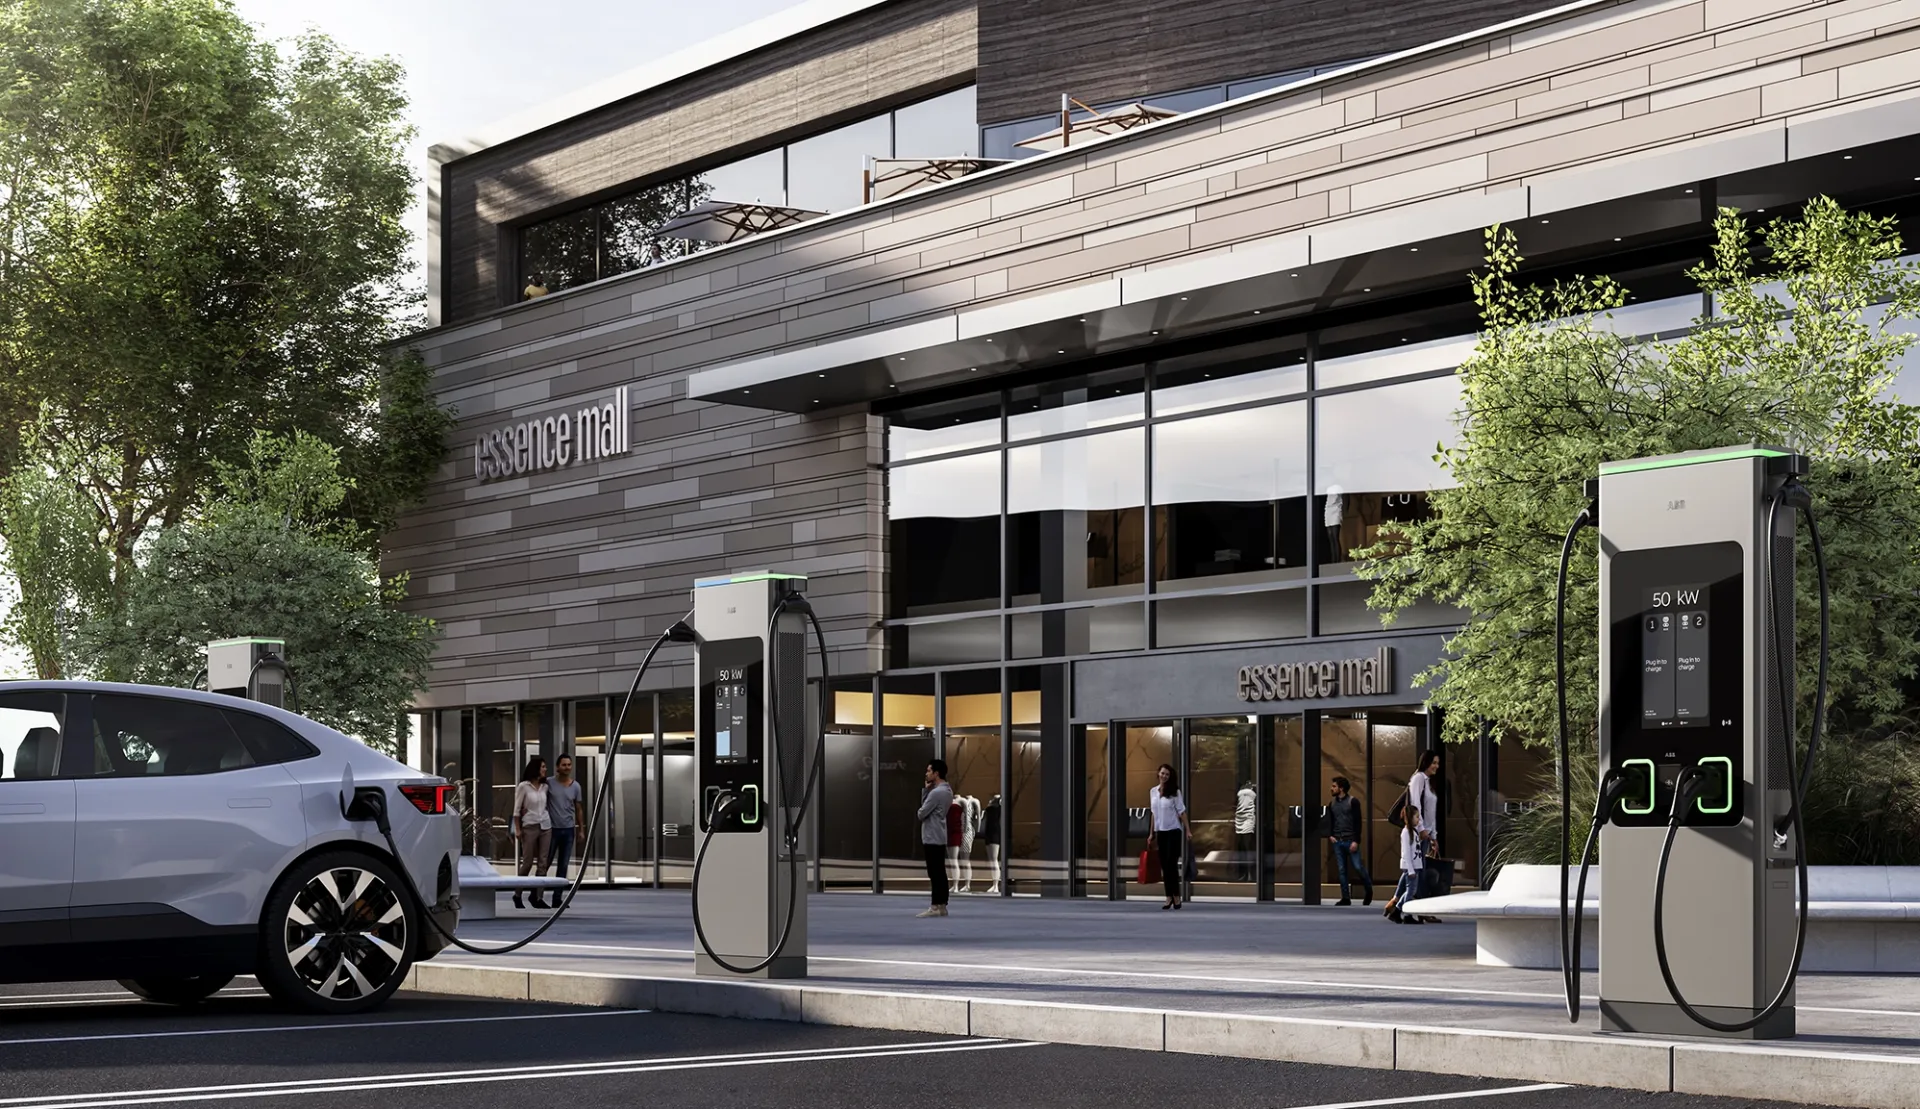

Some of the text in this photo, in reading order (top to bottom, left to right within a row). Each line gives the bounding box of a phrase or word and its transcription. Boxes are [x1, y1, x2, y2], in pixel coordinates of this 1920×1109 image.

[475, 385, 630, 481] essence mall
[1652, 589, 1700, 608] 50 kW
[1649, 620, 1655, 629] 1
[1696, 616, 1703, 626] 2
[719, 668, 743, 681] 50 kW
[1237, 646, 1394, 701] essence mall
